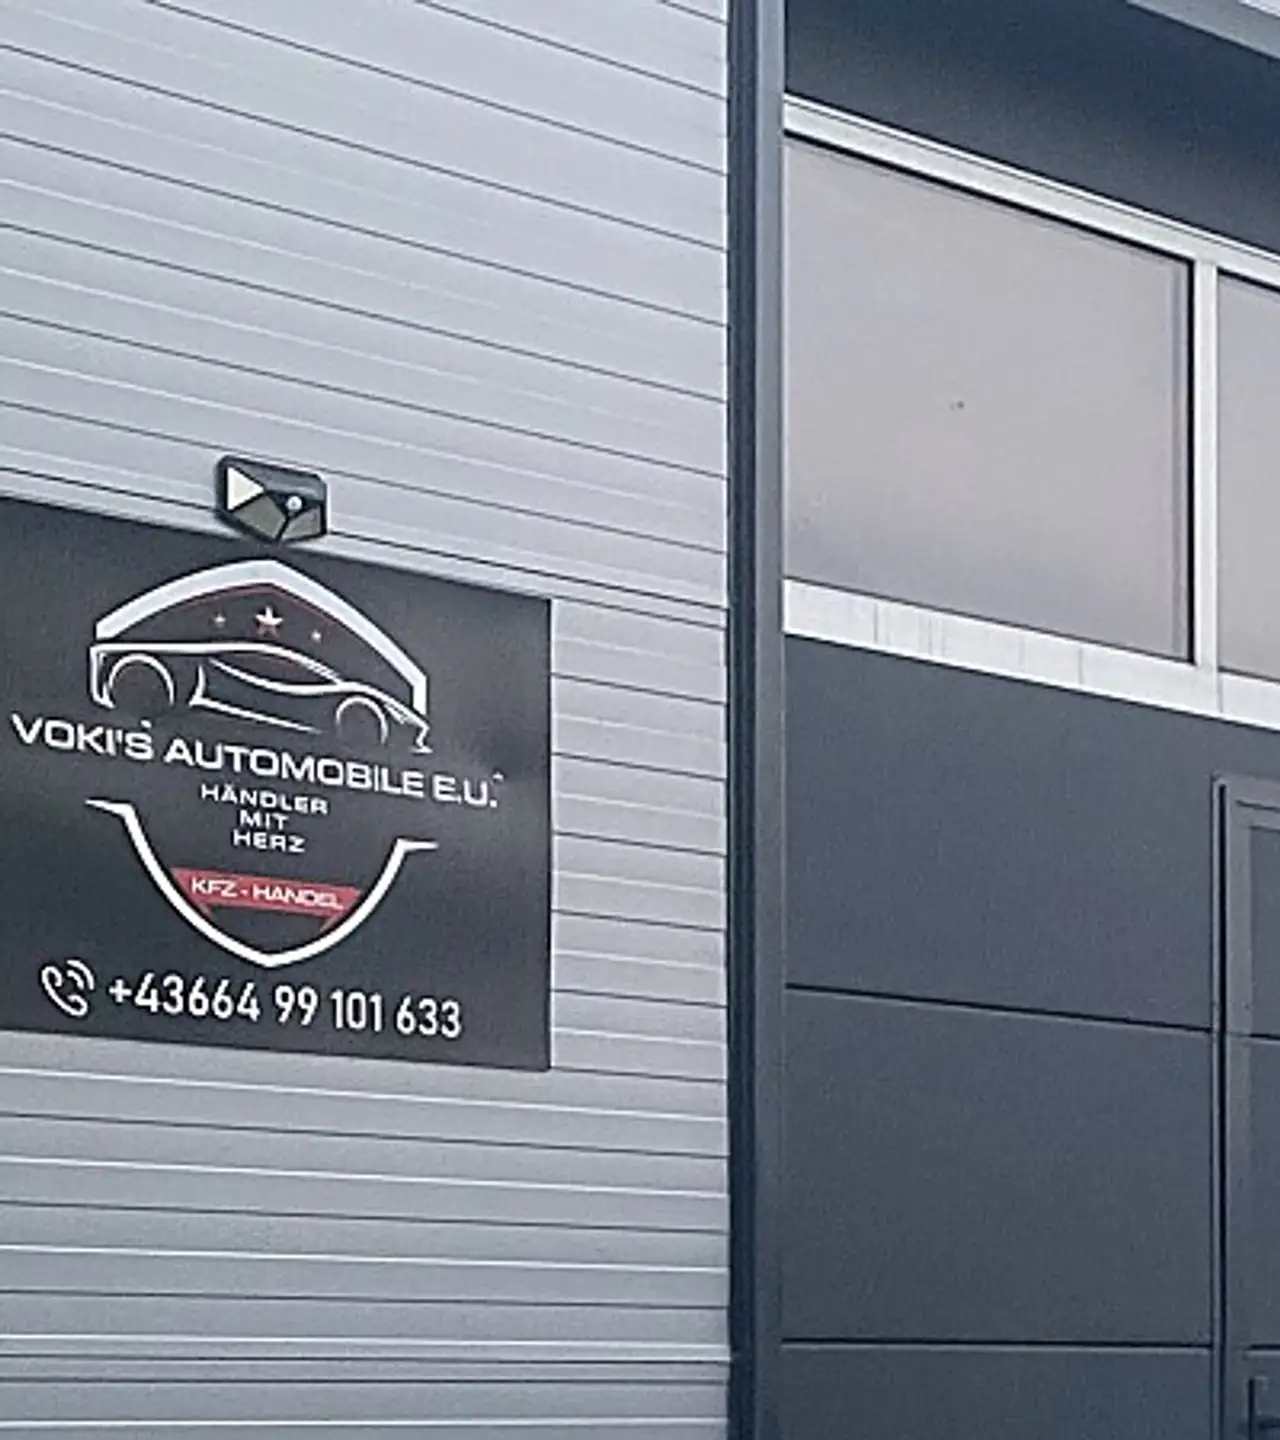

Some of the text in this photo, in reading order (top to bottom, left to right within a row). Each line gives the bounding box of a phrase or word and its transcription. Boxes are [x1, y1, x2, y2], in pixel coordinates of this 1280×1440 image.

[10, 712, 499, 808] VOKI'S AUTOMOBILE E.U.
[200, 782, 329, 816] HÄNDLER
[239, 810, 286, 832] MIT
[232, 830, 306, 854] HERZ
[190, 878, 238, 898] KFZ
[252, 884, 345, 910] HANDEL
[109, 973, 462, 1039] +43664 99 101 633
